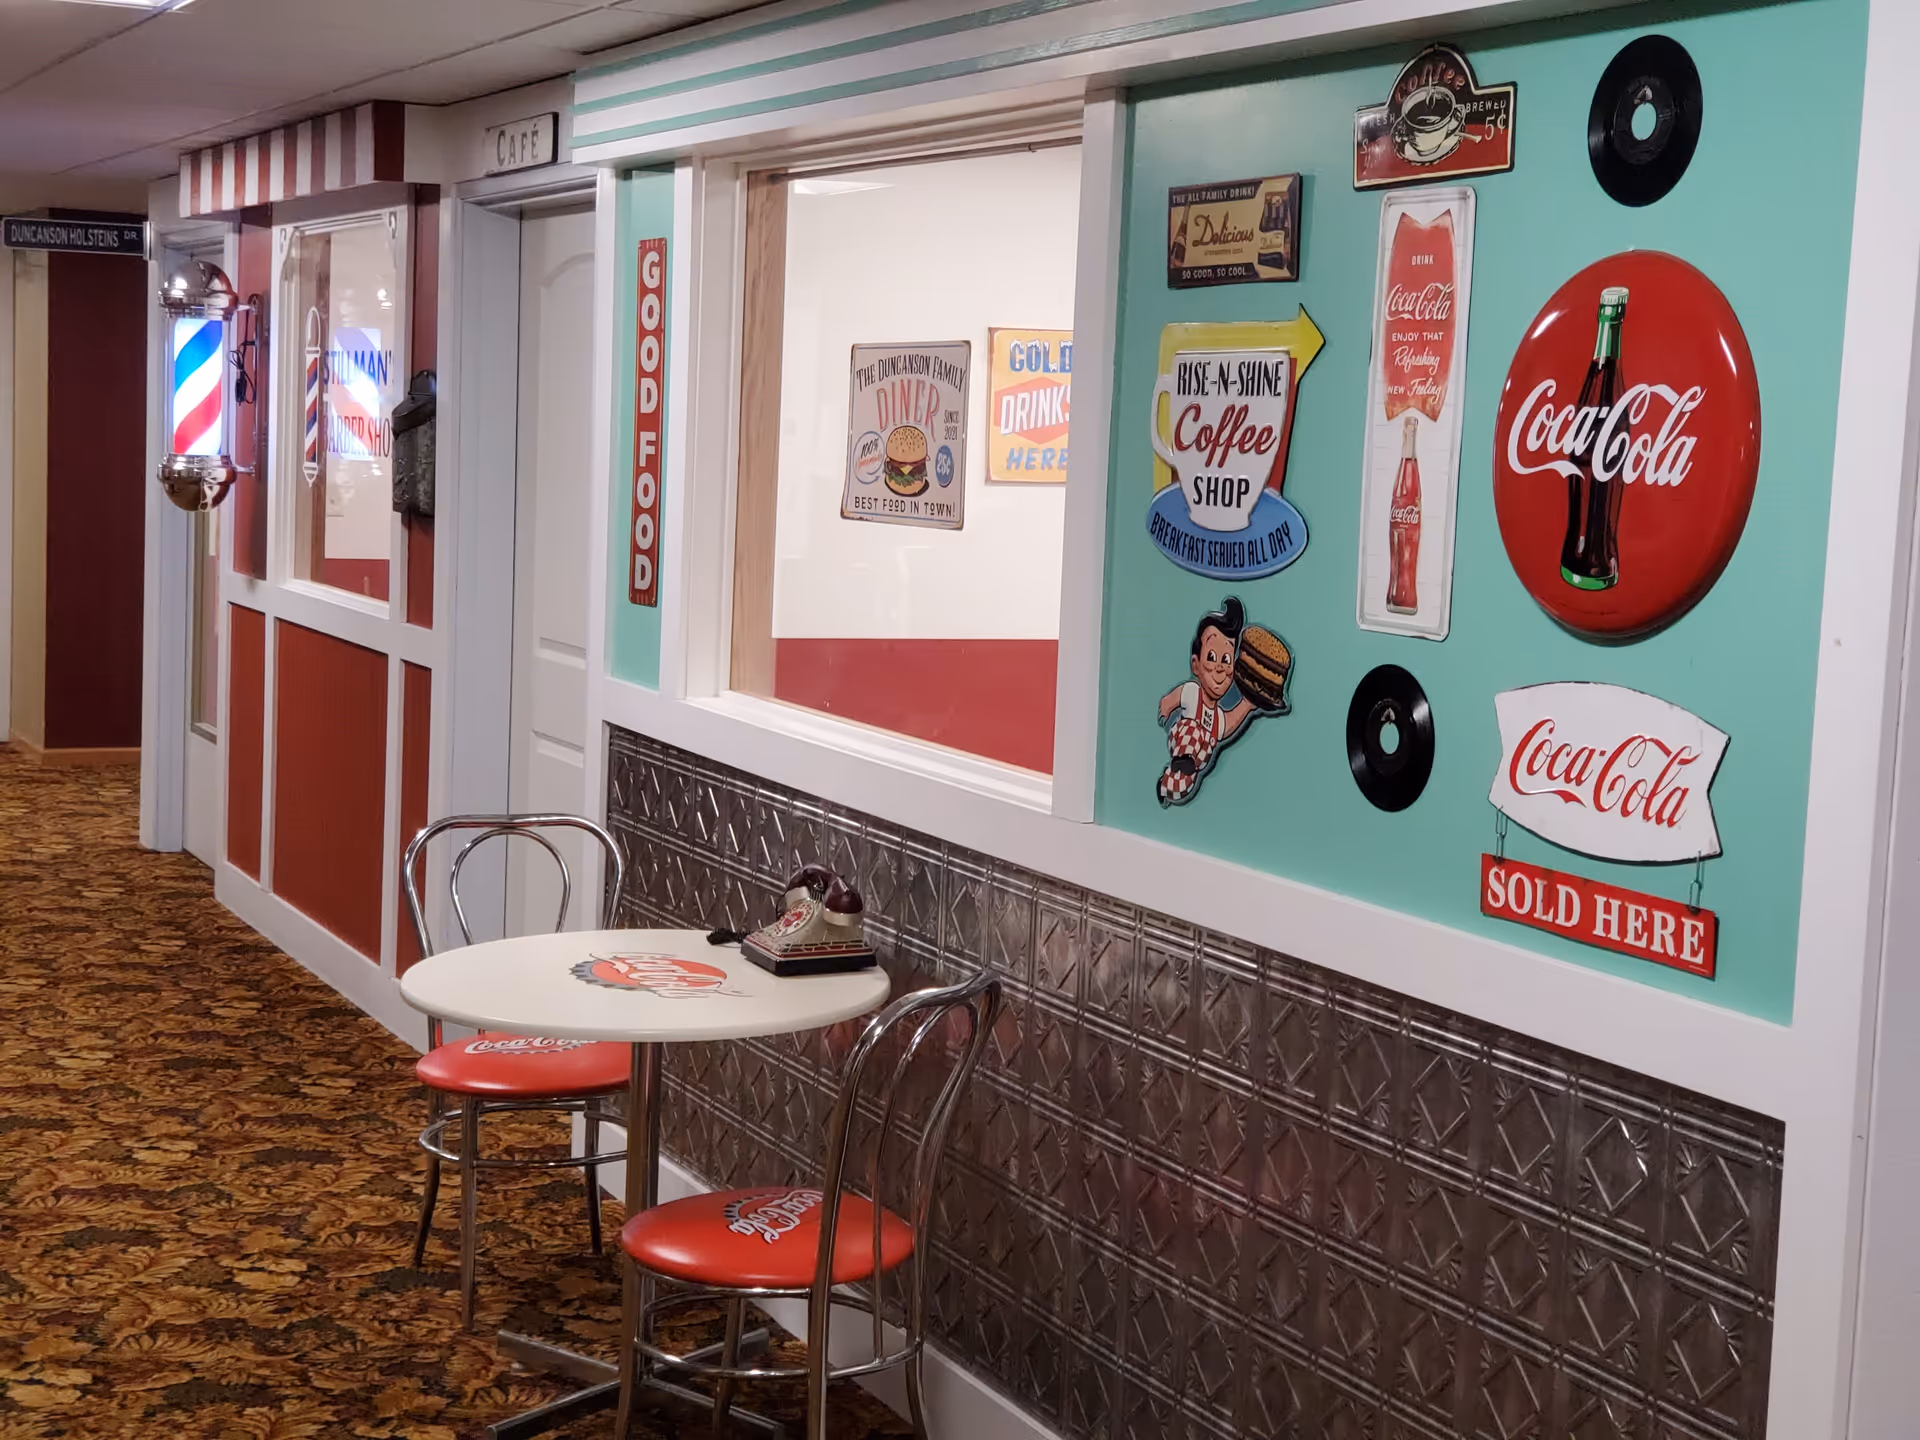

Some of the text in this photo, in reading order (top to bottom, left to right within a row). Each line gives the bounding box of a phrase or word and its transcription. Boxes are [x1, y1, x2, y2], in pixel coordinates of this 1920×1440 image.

[1466, 100, 1506, 113] BREWED
[497, 123, 539, 167] CAFÉ
[1172, 195, 1186, 204] THE
[11, 225, 69, 245] DUNCANSON
[70, 227, 119, 248] HOLSTEINS
[1192, 210, 1254, 247] Delicious
[1182, 270, 1191, 279] SO
[1217, 267, 1227, 277] SO
[1411, 254, 1434, 266] DRINK
[1385, 282, 1455, 321] Coca-Cola
[640, 250, 660, 414] GOOD
[1392, 331, 1444, 342] ENJOY THAT
[323, 349, 394, 386] STILLMAN'
[856, 354, 967, 393] THE DUNCANSON FAMILY
[1009, 339, 1073, 373] COLD
[1392, 346, 1440, 376] Refreshing
[1177, 360, 1284, 397] RISE-N-SHINE
[1387, 377, 1442, 405] NEW Feeling
[876, 378, 940, 443] DINER
[944, 409, 960, 424] SINCE
[368, 417, 391, 458] SHO
[1174, 402, 1277, 468] Coffee
[1507, 379, 1707, 487] Coca-Cola
[1006, 447, 1068, 471] HERE
[634, 431, 657, 590] FOOD
[854, 496, 956, 518] BEST FOOD IN TOWN!
[1193, 475, 1250, 509] SHOP
[1150, 512, 1293, 569] BREAKFAST SERVED ALL DAY
[1509, 717, 1701, 828] Coca-Cola
[1487, 865, 1705, 965] SOLD HERE
[464, 1036, 601, 1055] Coca-Co
[728, 1189, 824, 1244] oca-Cola
